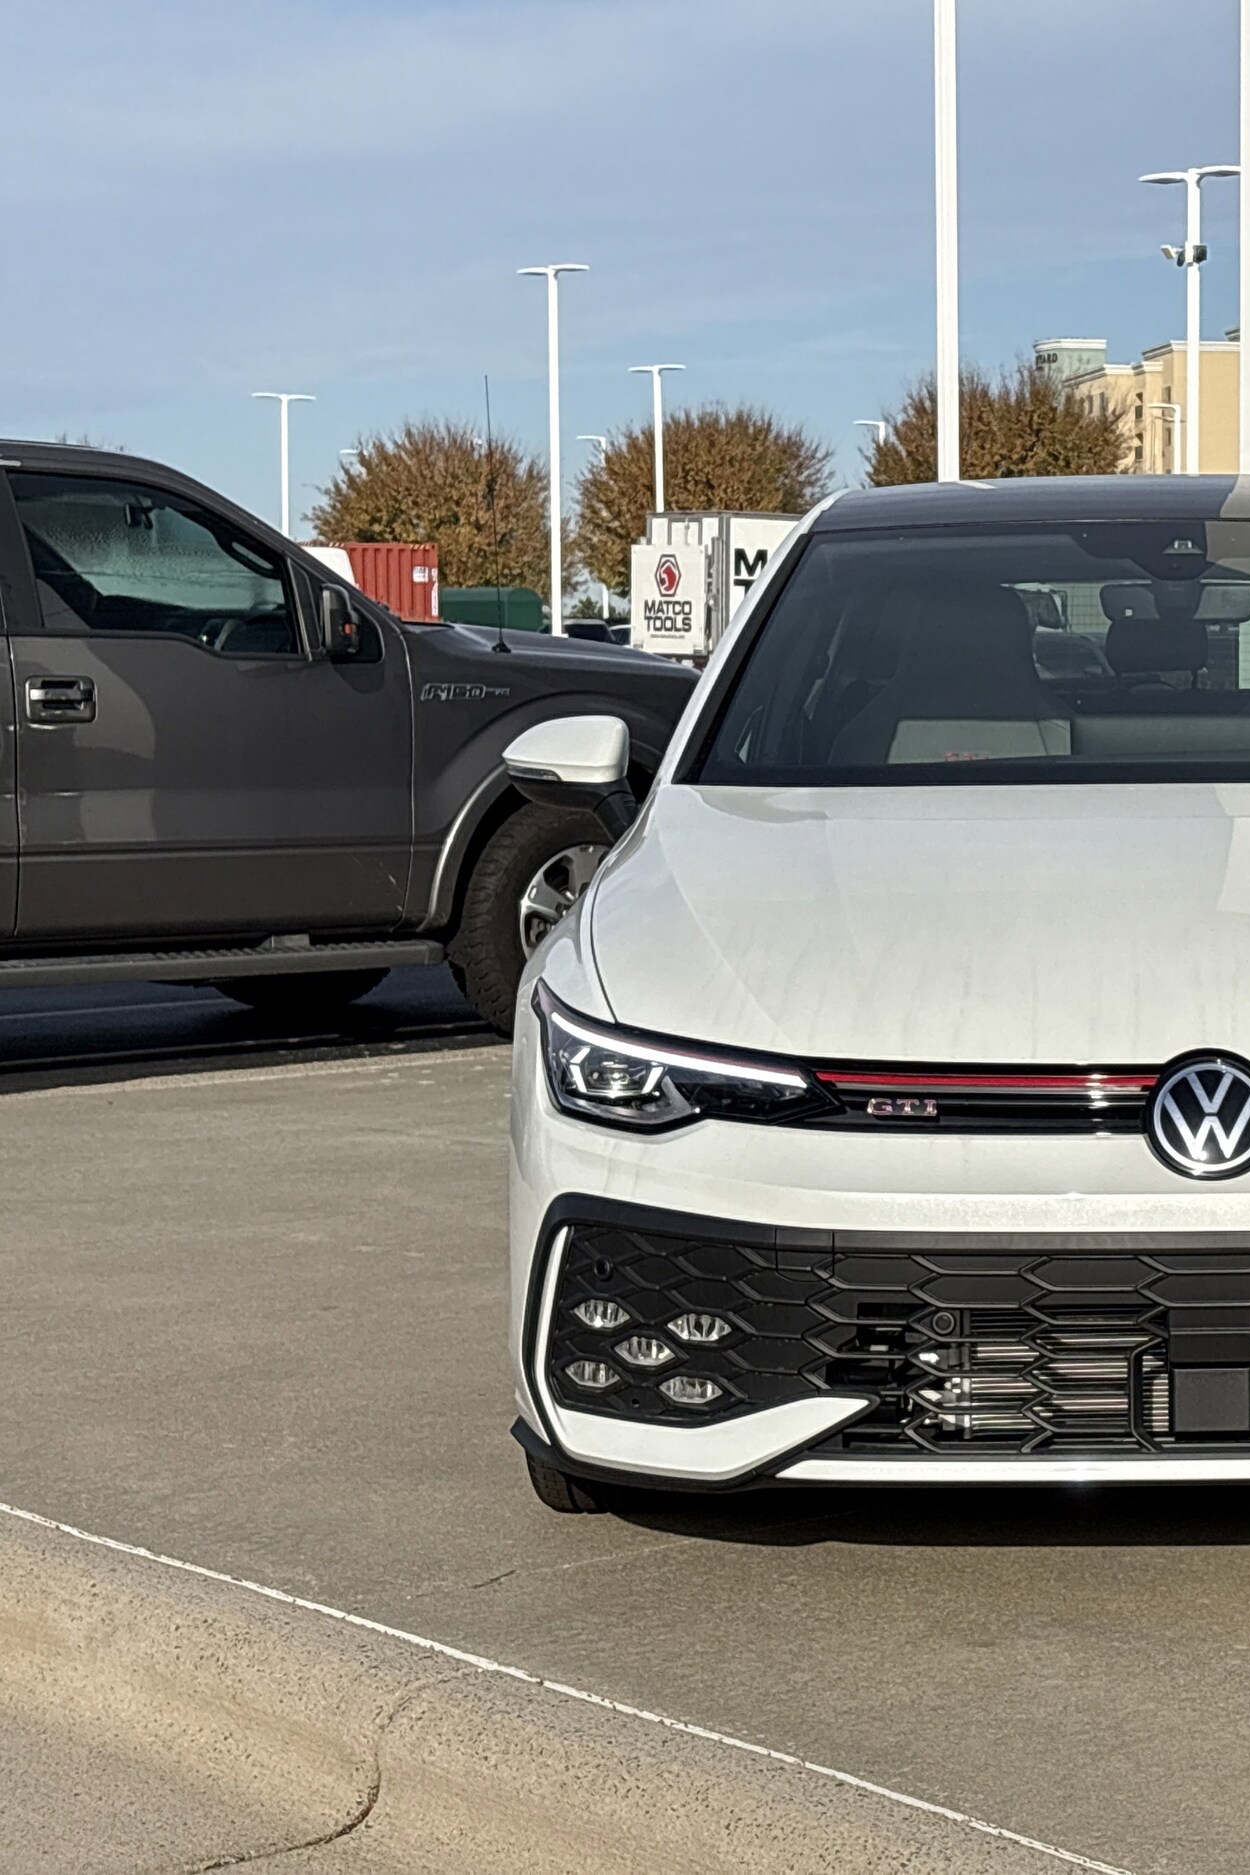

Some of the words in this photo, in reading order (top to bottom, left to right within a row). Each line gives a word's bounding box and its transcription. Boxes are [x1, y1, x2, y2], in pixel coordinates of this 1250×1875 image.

[644, 600, 692, 615] MATCO
[644, 615, 692, 632] TOOLS
[867, 1098, 937, 1116] GTI
